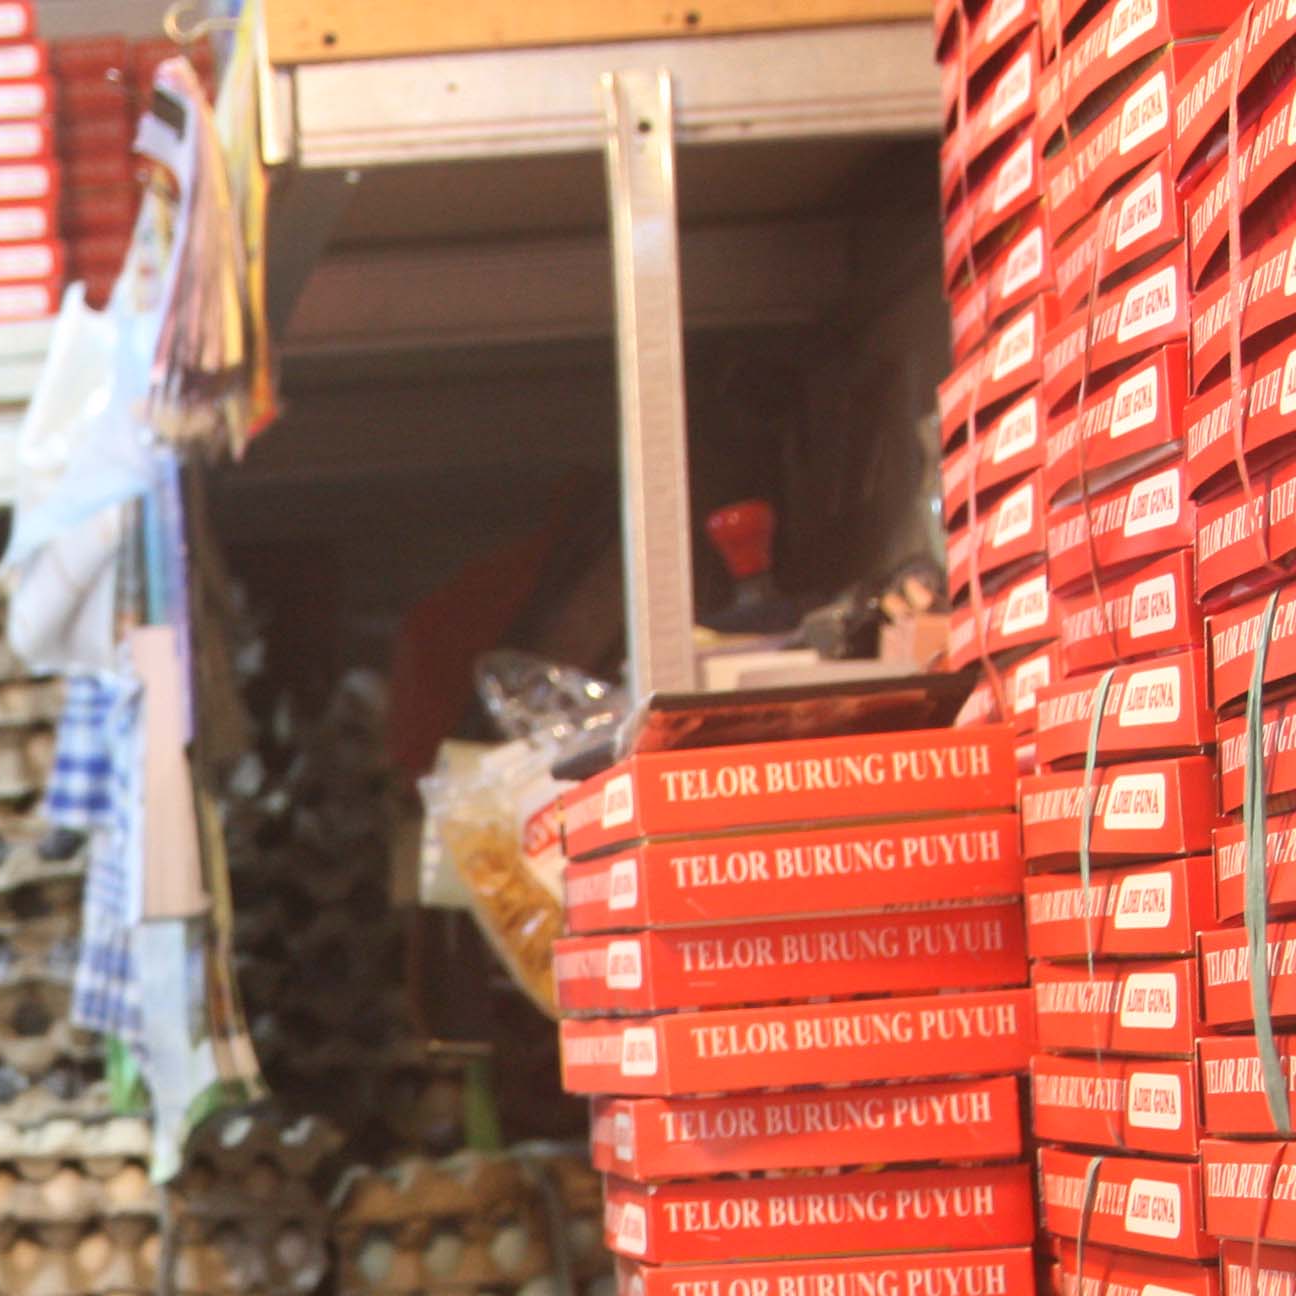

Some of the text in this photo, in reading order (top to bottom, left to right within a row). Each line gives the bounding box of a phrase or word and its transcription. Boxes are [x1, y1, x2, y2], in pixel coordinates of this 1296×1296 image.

[660, 745, 990, 802] TELOR BURUNG PUYUH
[670, 850, 769, 888] TELOR
[774, 839, 895, 879] BURUNG
[901, 830, 999, 868] PUYUH
[677, 938, 775, 973] TELOR
[781, 929, 899, 966] BURUNG
[906, 921, 1003, 957] PUYUH
[690, 1021, 789, 1058] TELOR
[793, 1012, 913, 1050] BURUNG
[919, 1004, 1016, 1041] PUYUH
[659, 1091, 992, 1143] TELOR BURUNG PUYUH
[663, 1185, 994, 1233] TELOR BURUNG PUYUH
